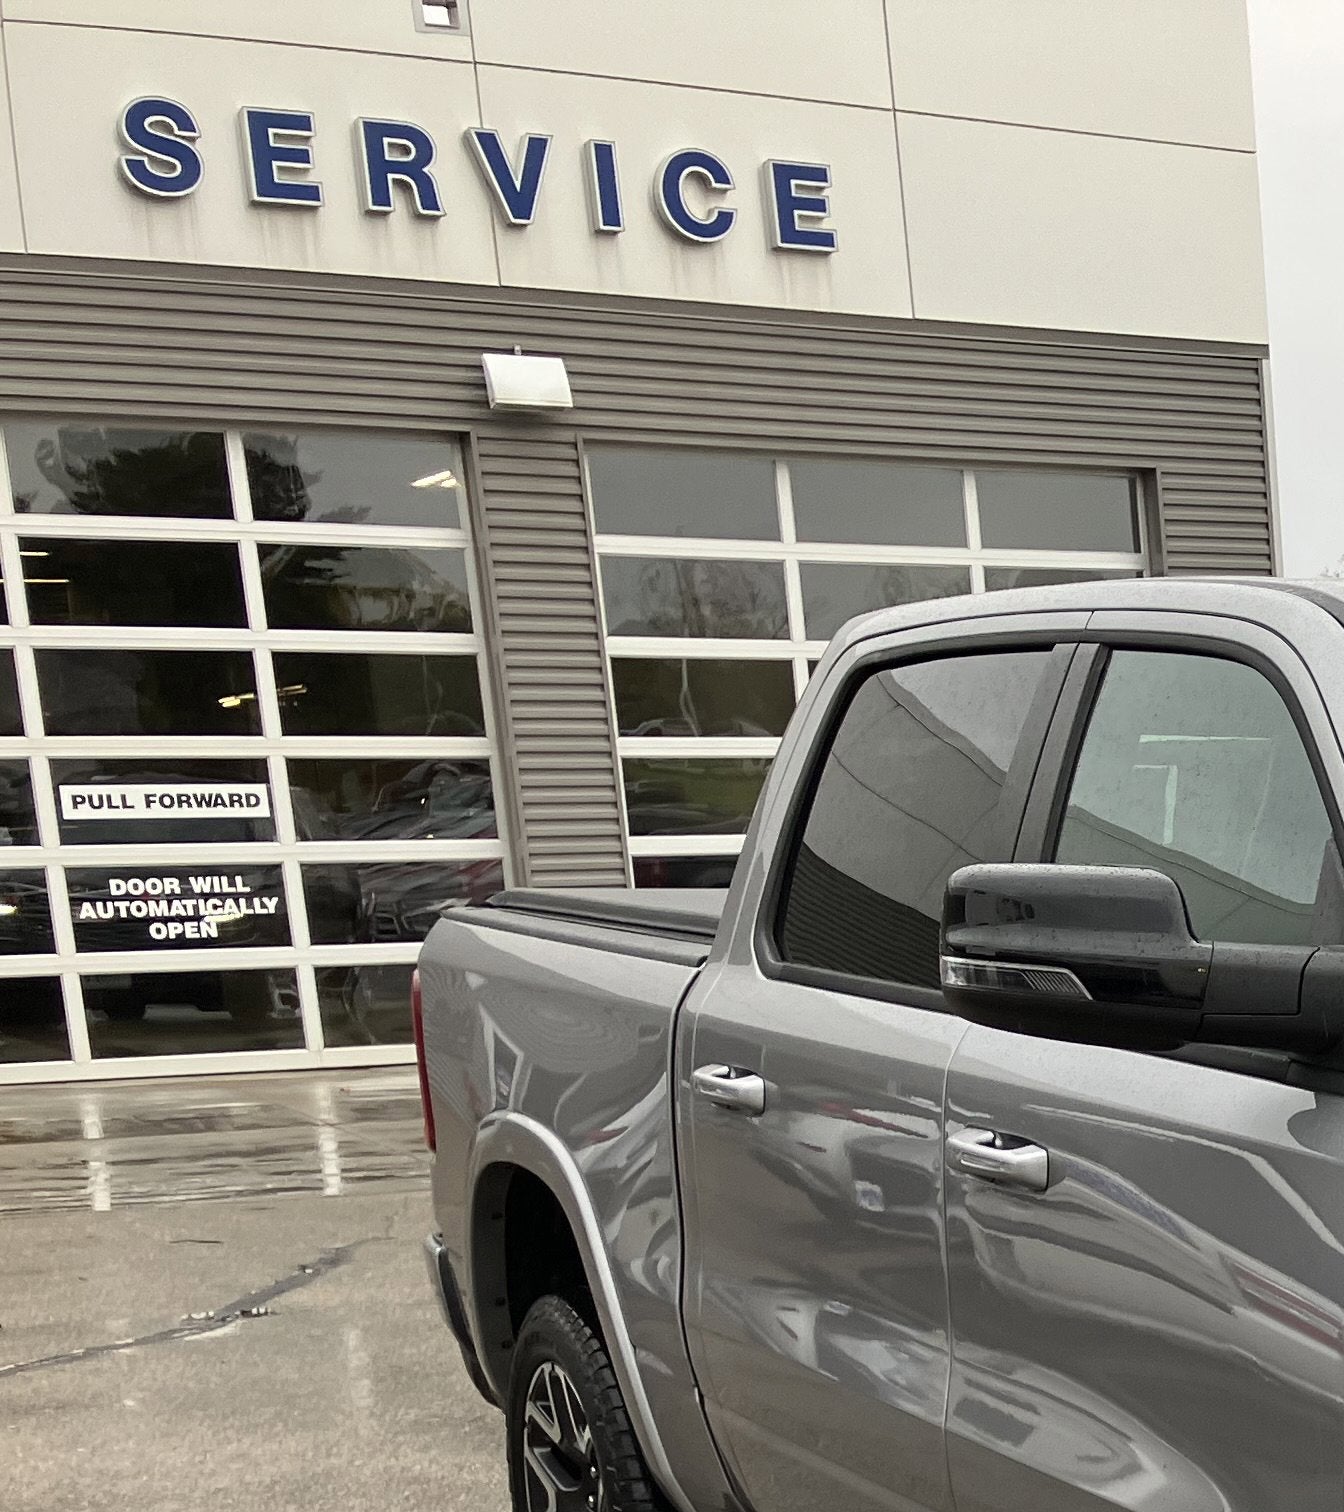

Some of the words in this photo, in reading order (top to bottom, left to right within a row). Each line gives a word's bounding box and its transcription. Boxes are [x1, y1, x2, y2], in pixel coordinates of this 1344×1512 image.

[119, 95, 839, 253] SERVICE
[71, 794, 135, 809] PULL
[144, 793, 261, 809] FORWARD
[109, 877, 181, 896] DOOR
[189, 875, 251, 894] WILL
[79, 897, 279, 920] AUTOMATICALLY
[150, 921, 219, 940] OPEN
